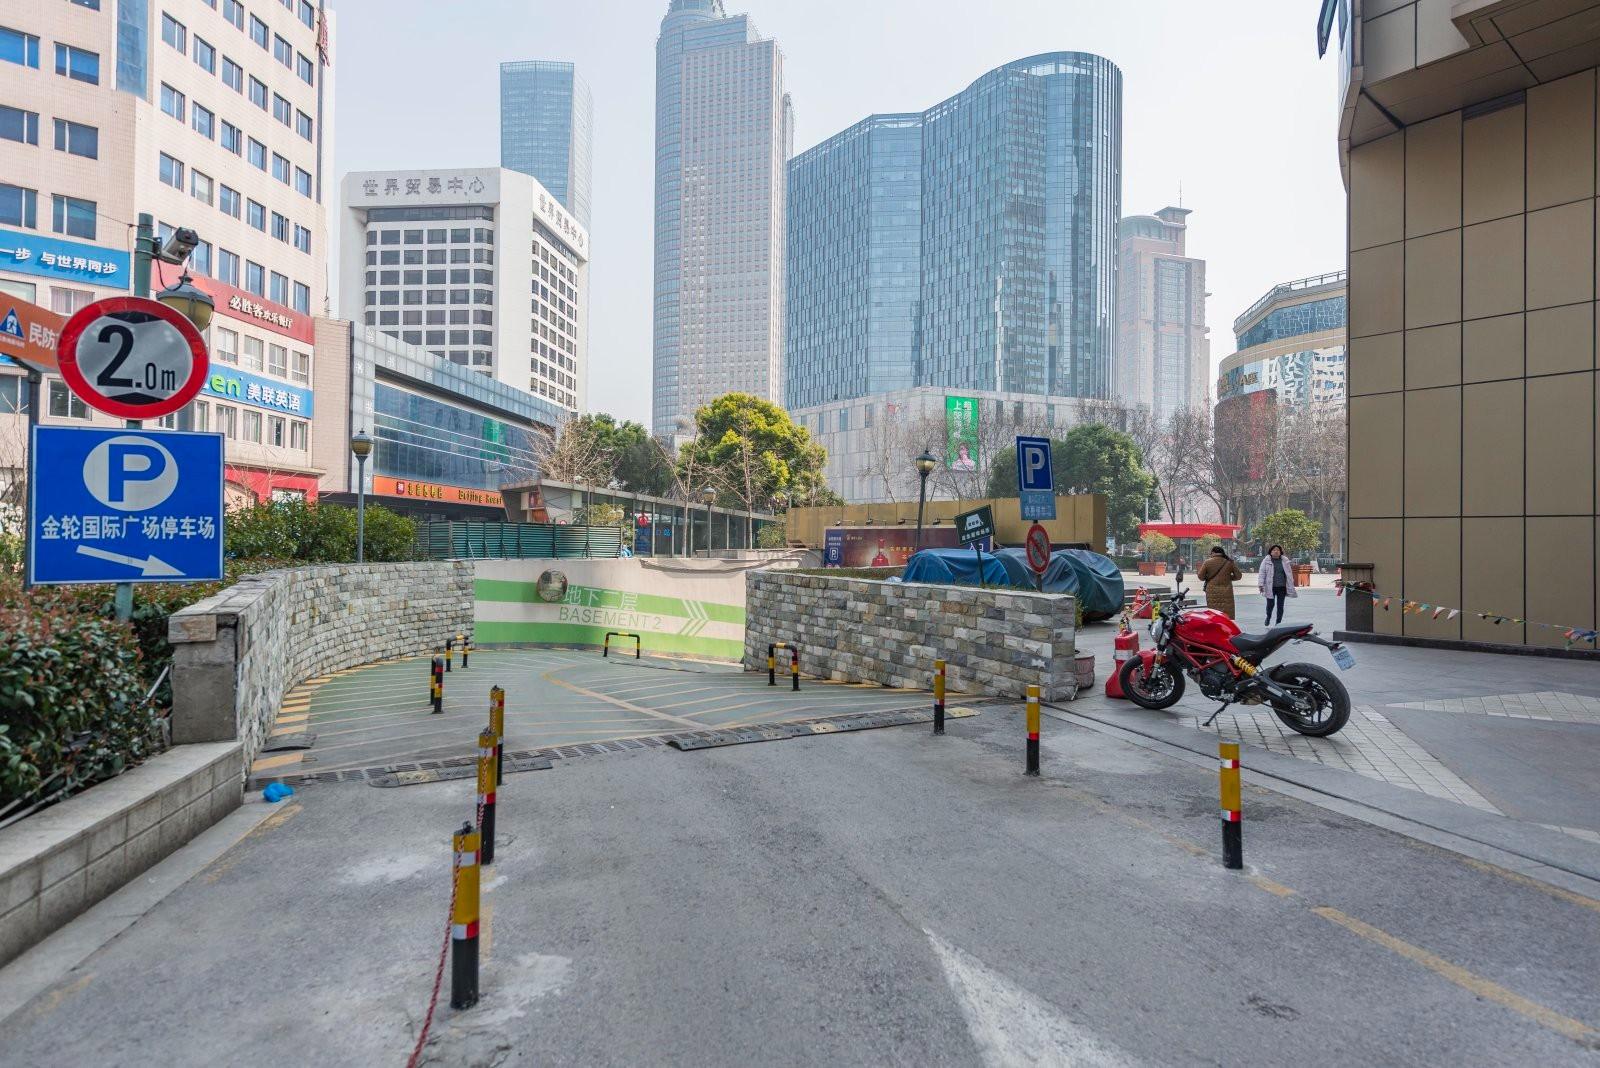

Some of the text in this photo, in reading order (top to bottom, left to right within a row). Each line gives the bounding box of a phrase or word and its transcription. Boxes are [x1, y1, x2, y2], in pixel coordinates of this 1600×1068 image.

[362, 176, 485, 196] 世界贸易中心
[41, 252, 119, 274] 与世界同步
[29, 322, 58, 350] 民防
[247, 383, 301, 411] 美联英语
[108, 444, 166, 502] P
[1025, 448, 1045, 484] P
[41, 515, 215, 540] 金轮国际广场停车场
[563, 585, 638, 613] 地下二层
[559, 606, 664, 630] BASEMENT 2
